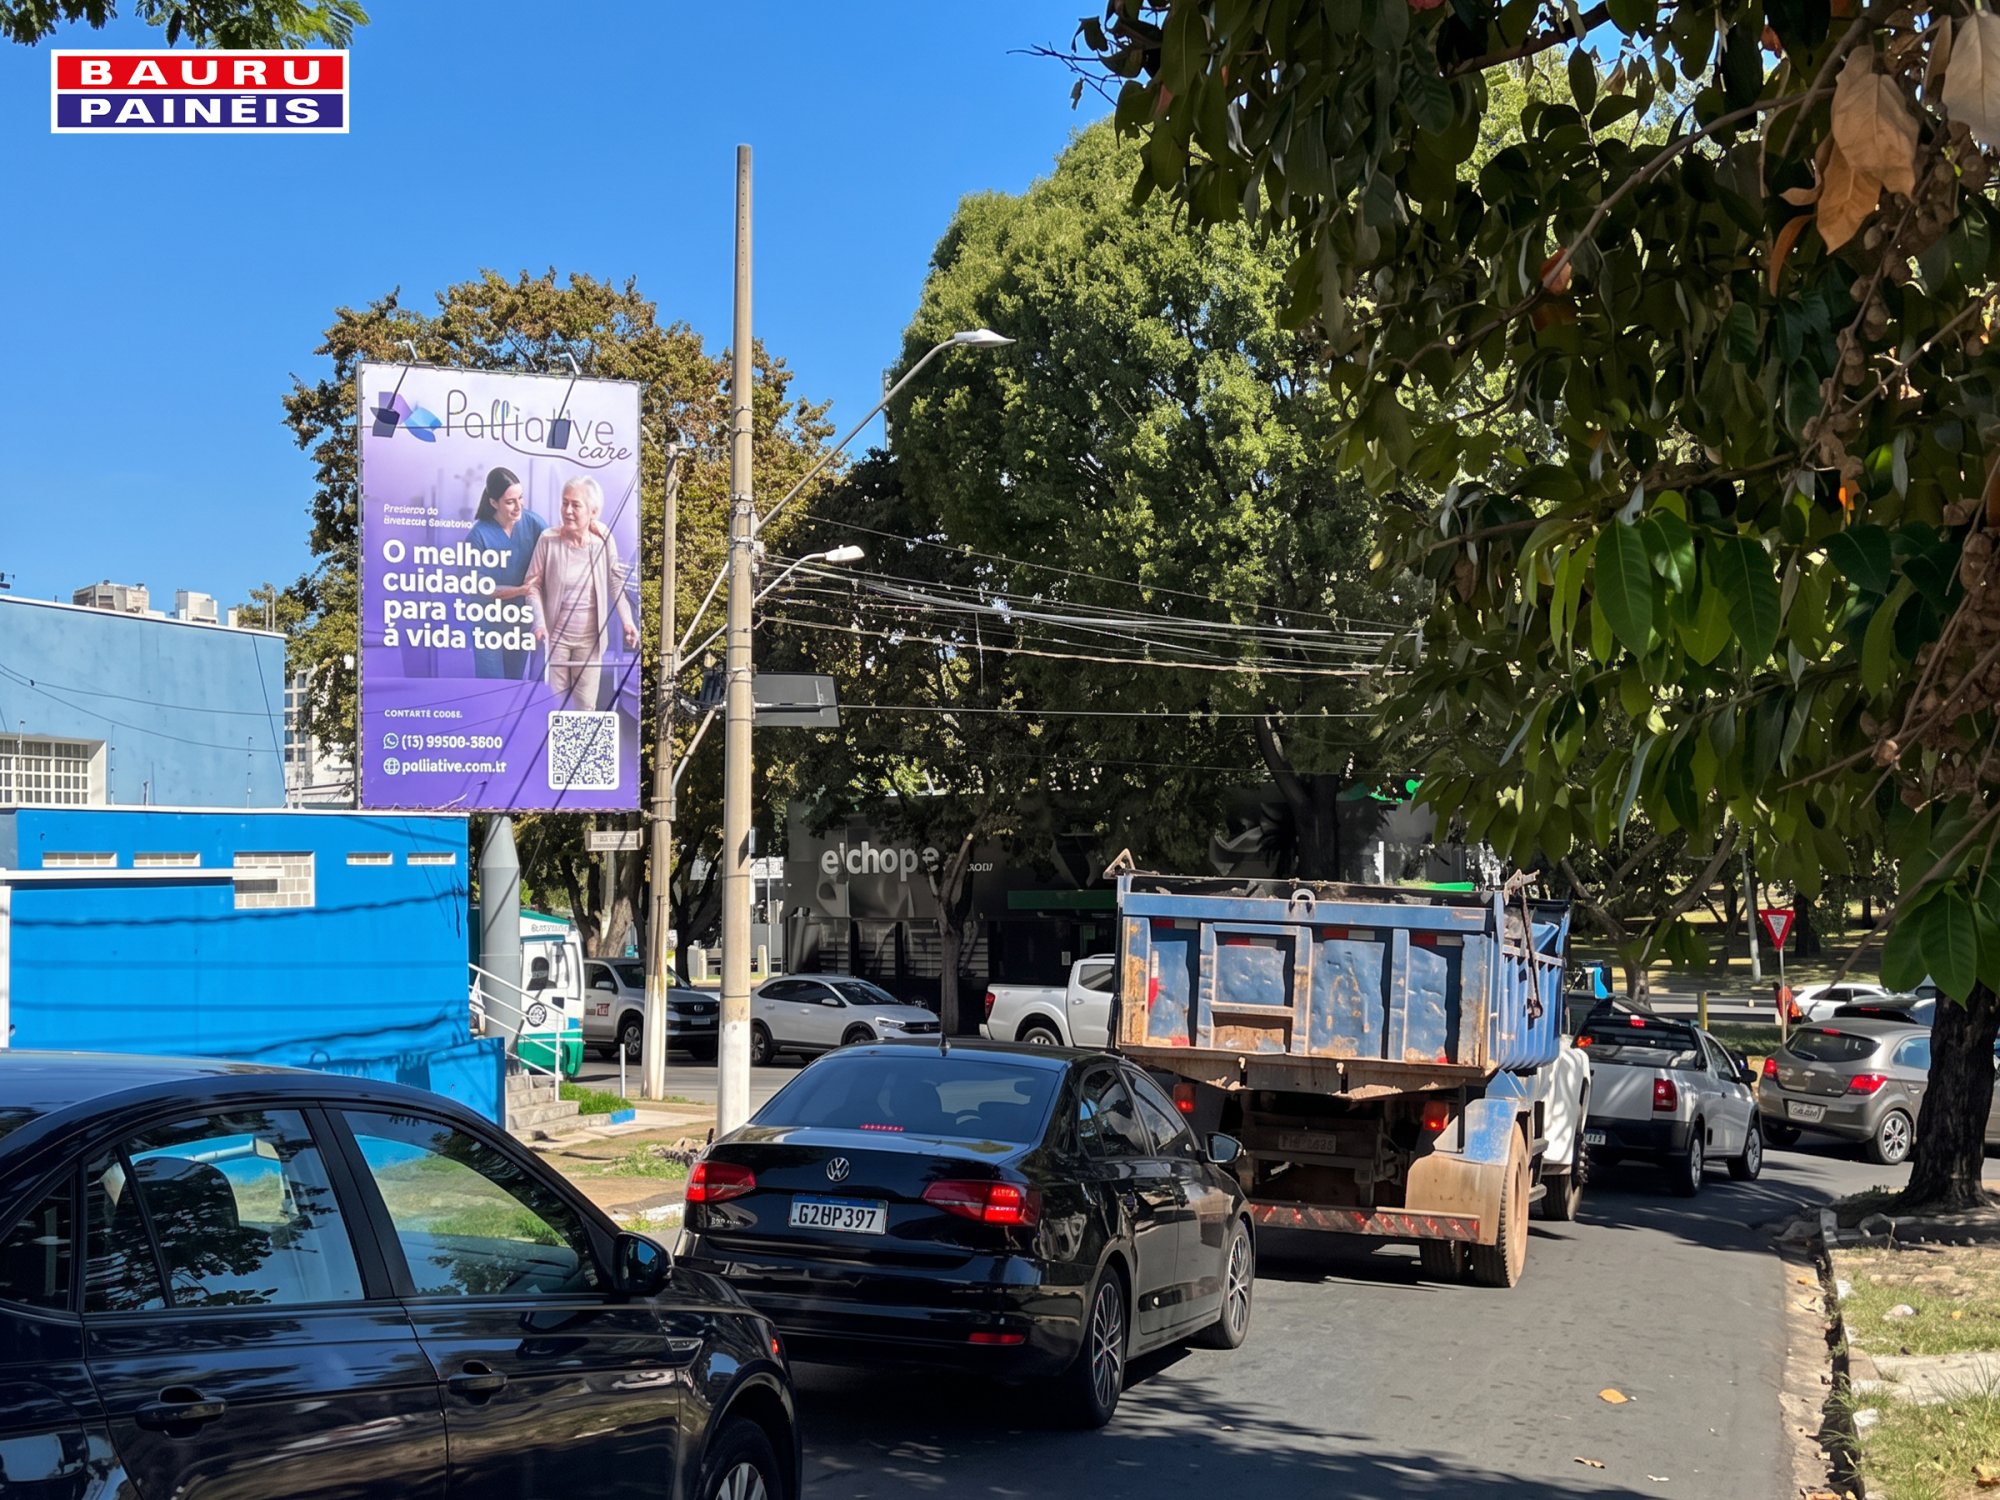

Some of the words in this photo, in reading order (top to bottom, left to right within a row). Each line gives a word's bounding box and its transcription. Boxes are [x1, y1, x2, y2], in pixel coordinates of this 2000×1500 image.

[446, 389, 615, 447] Palliatve
[578, 443, 633, 461] care
[383, 540, 406, 563] O
[413, 543, 512, 569] melhor
[383, 569, 496, 595] cuidado
[384, 598, 446, 625] para
[454, 598, 534, 624] todos
[406, 624, 466, 649] vida
[472, 626, 536, 651] toda
